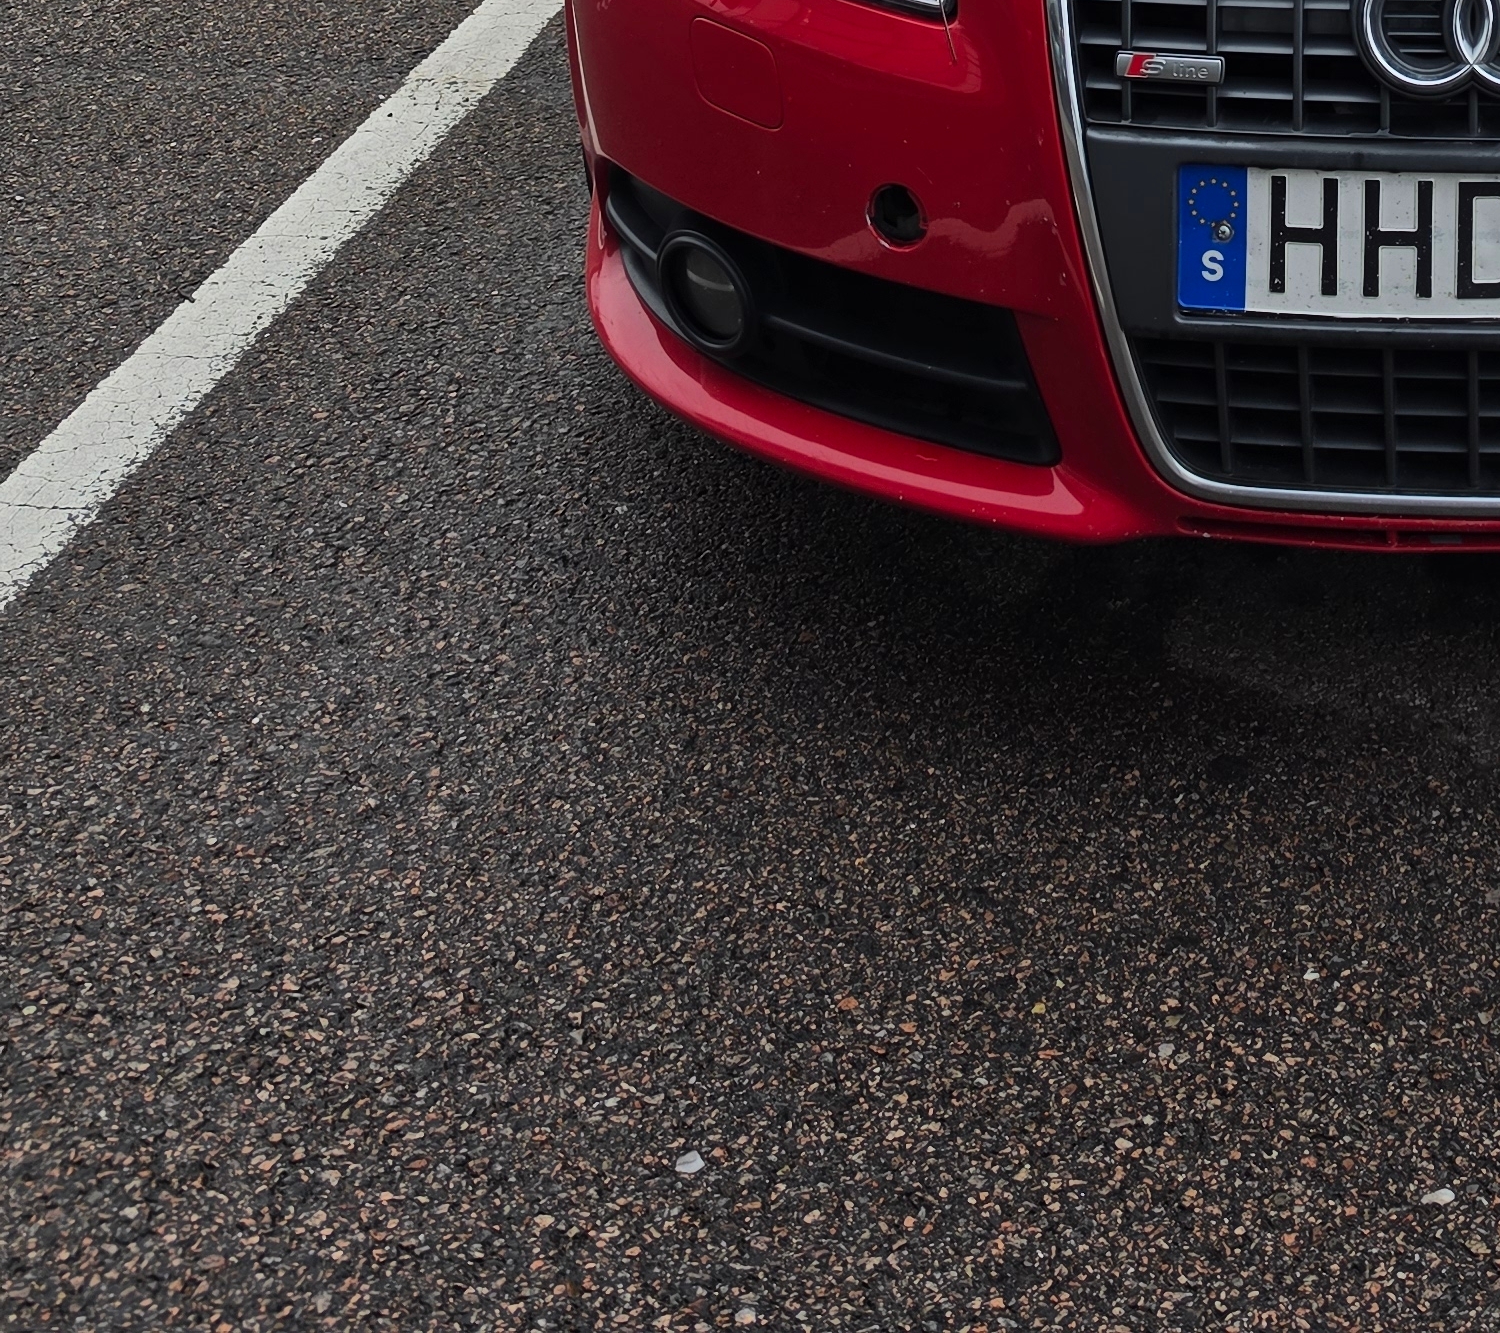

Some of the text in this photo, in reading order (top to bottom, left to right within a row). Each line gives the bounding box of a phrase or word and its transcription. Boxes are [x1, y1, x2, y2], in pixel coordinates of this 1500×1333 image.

[1140, 58, 1209, 79] S line
[1201, 249, 1225, 282] S
